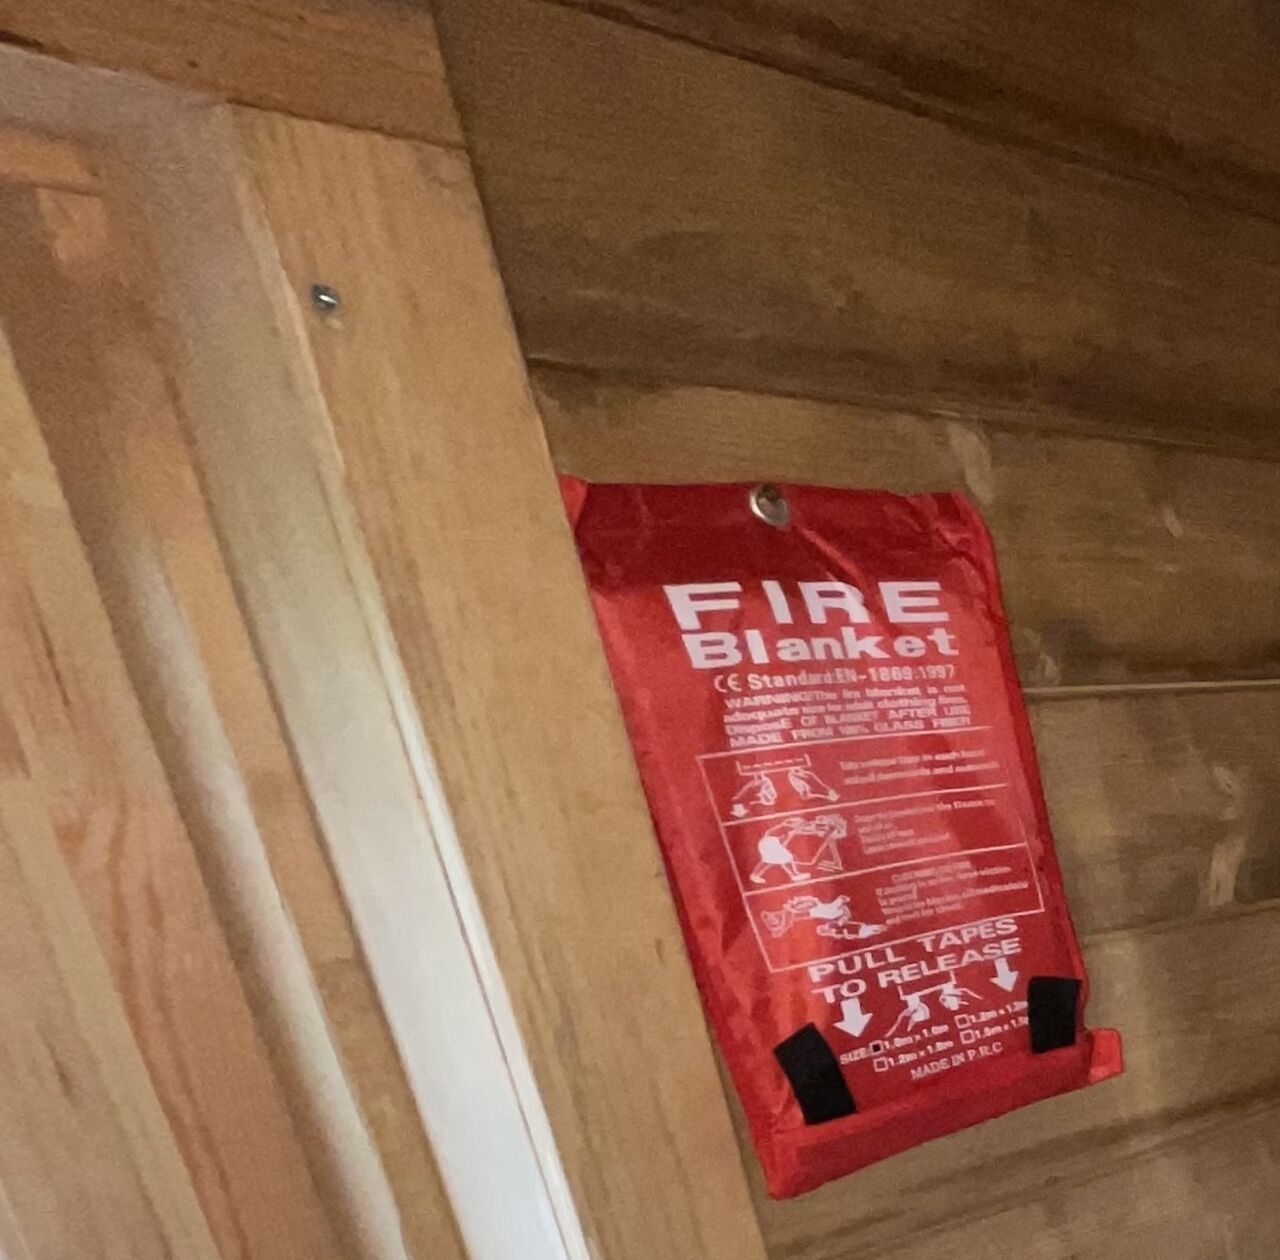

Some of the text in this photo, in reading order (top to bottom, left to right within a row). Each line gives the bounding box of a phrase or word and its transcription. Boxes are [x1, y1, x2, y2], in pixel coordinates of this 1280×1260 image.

[662, 580, 950, 630] FIRE
[682, 627, 959, 668] Blanket
[807, 918, 1018, 983] PULL TAPES
[811, 938, 1021, 1004] TO RELEASE
[910, 1057, 950, 1080] MADE
[952, 1052, 965, 1067] IN
